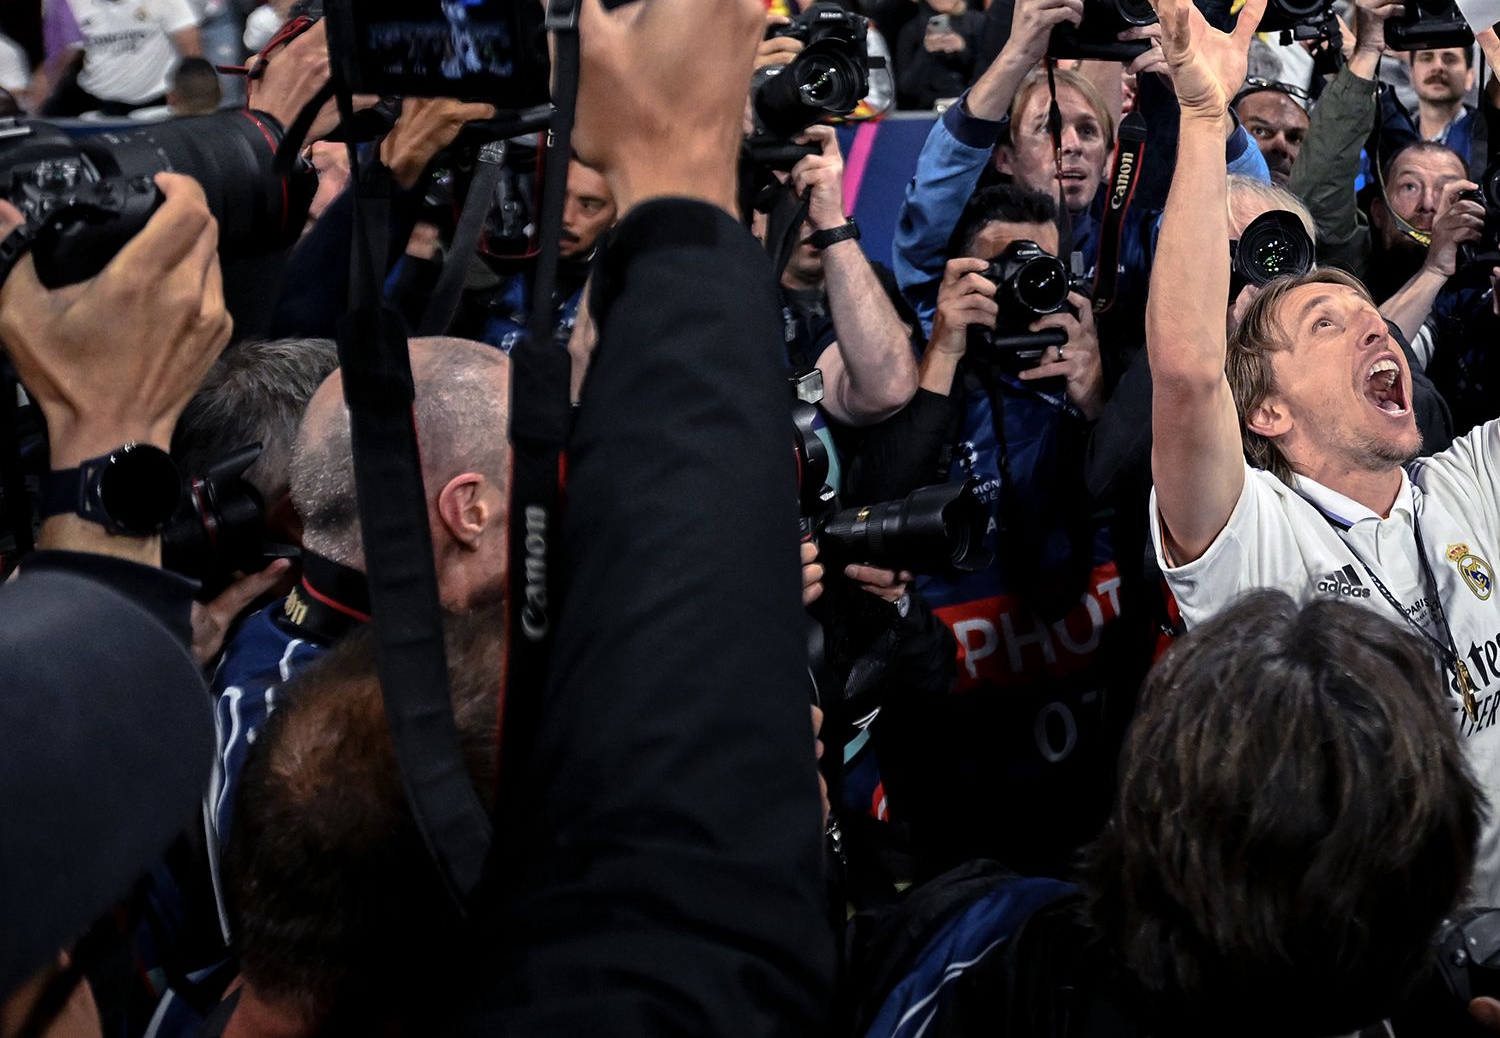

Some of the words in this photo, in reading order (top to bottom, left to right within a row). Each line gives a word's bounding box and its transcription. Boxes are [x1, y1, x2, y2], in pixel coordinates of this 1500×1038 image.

[820, 11, 843, 19] Nikon
[1111, 152, 1135, 210] Canon
[521, 506, 547, 640] Canon
[1317, 580, 1371, 599] adidas
[1405, 596, 1430, 617] PARIS
